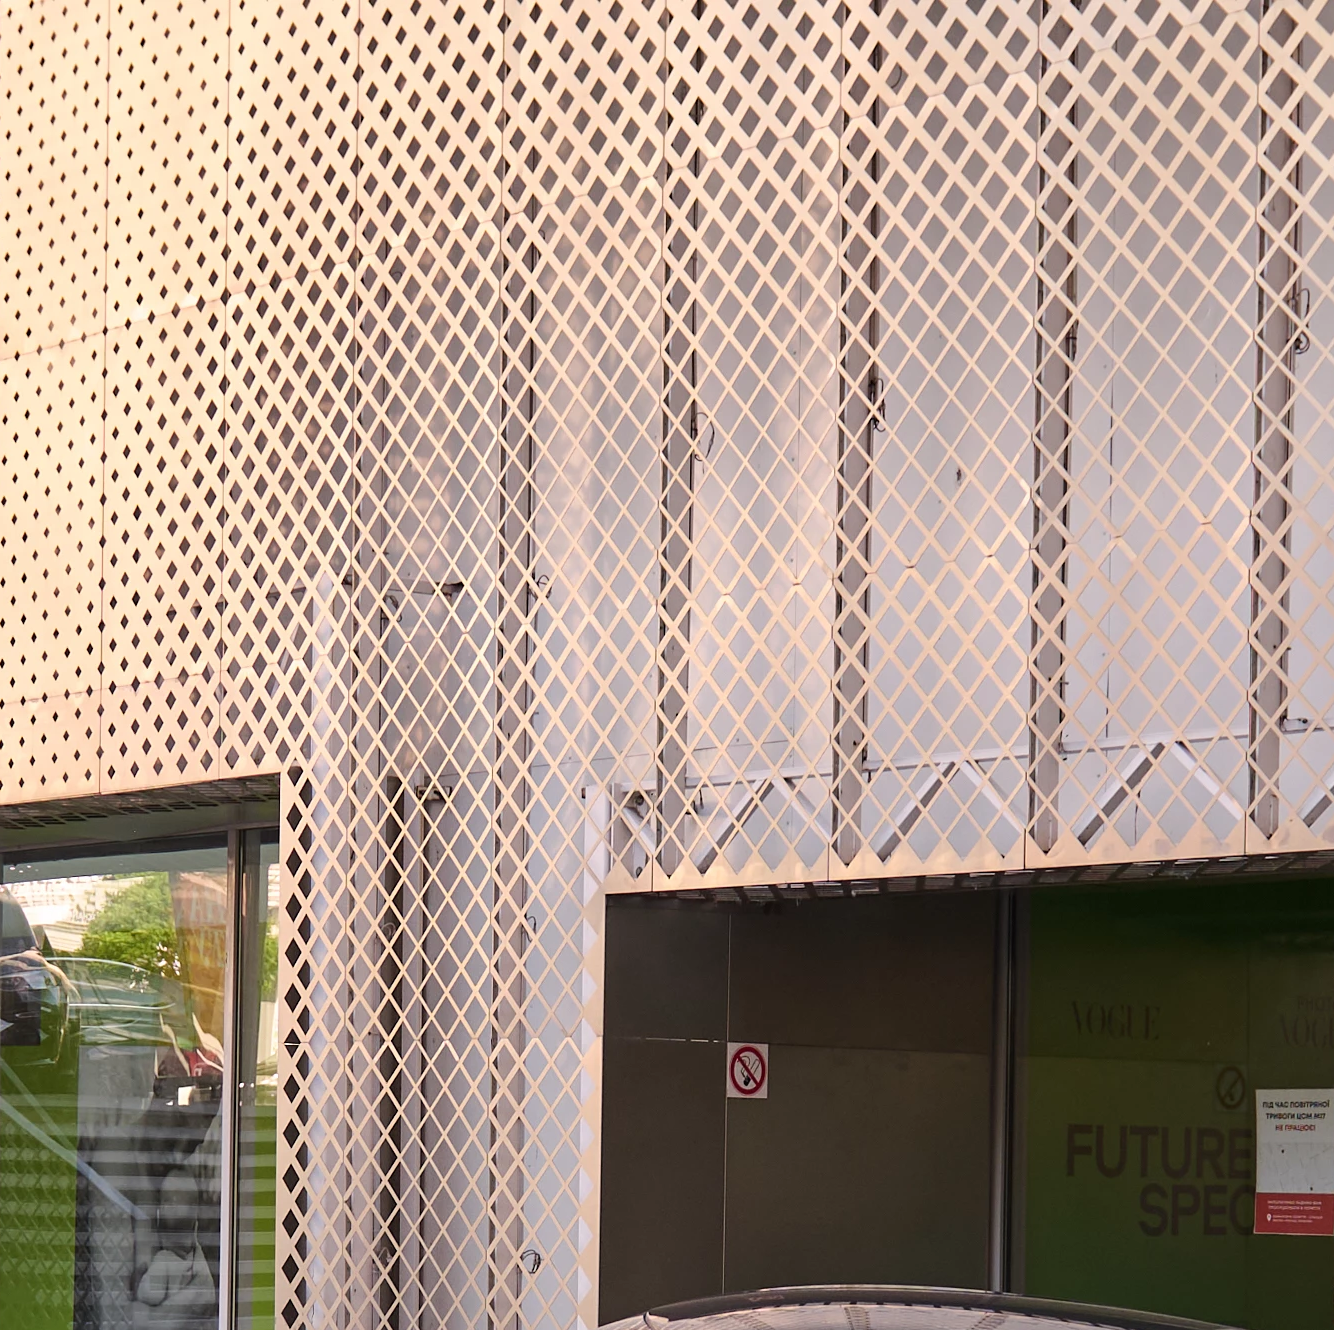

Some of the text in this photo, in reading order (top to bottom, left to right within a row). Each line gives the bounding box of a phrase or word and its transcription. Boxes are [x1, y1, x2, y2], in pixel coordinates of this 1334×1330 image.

[1070, 1000, 1162, 1041] VOGUE
[1275, 1101, 1289, 1109] ЧАС
[1065, 1123, 1252, 1180] FUTURE
